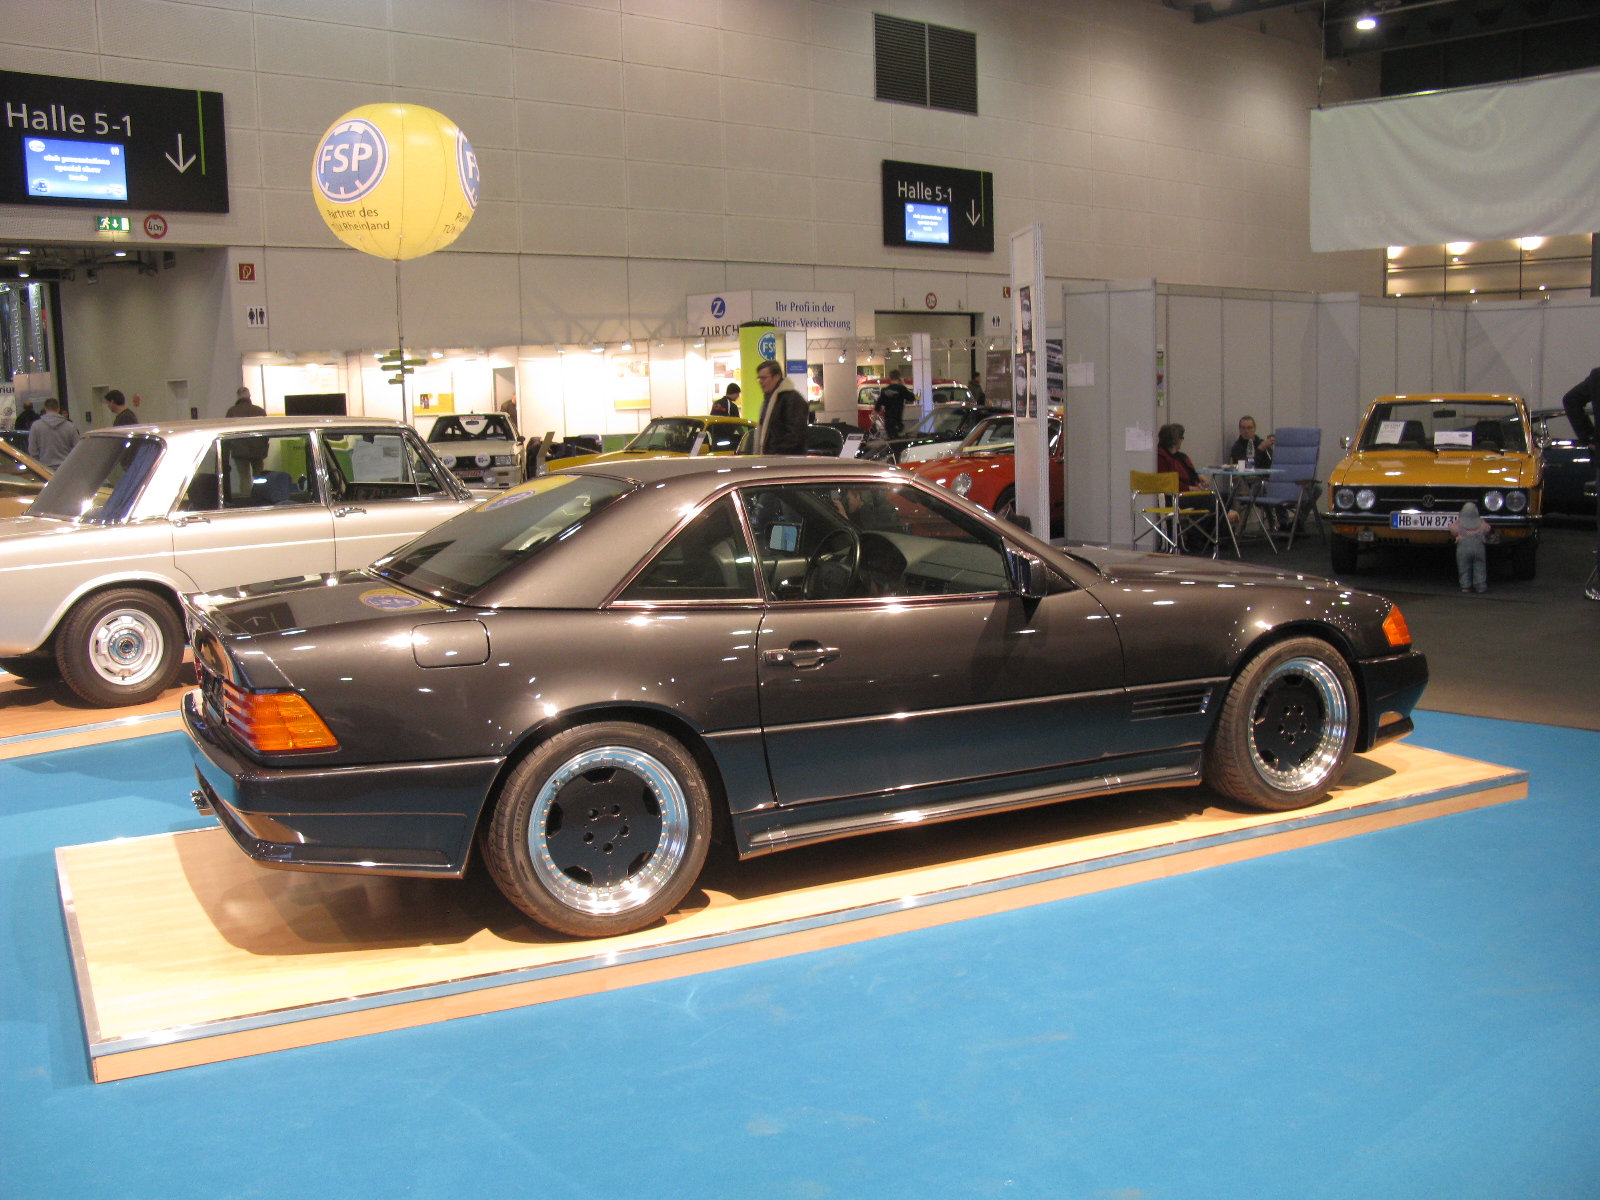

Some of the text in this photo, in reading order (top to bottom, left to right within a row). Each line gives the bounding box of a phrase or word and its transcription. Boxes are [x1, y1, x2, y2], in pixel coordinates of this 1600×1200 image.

[6, 102, 132, 137] Halle 5-1
[320, 143, 373, 174] FSP
[897, 181, 952, 202] Halle 5-1
[359, 207, 379, 218] des
[775, 300, 835, 312] Ihr Profi in der
[1399, 515, 1458, 527] HB VW 873
